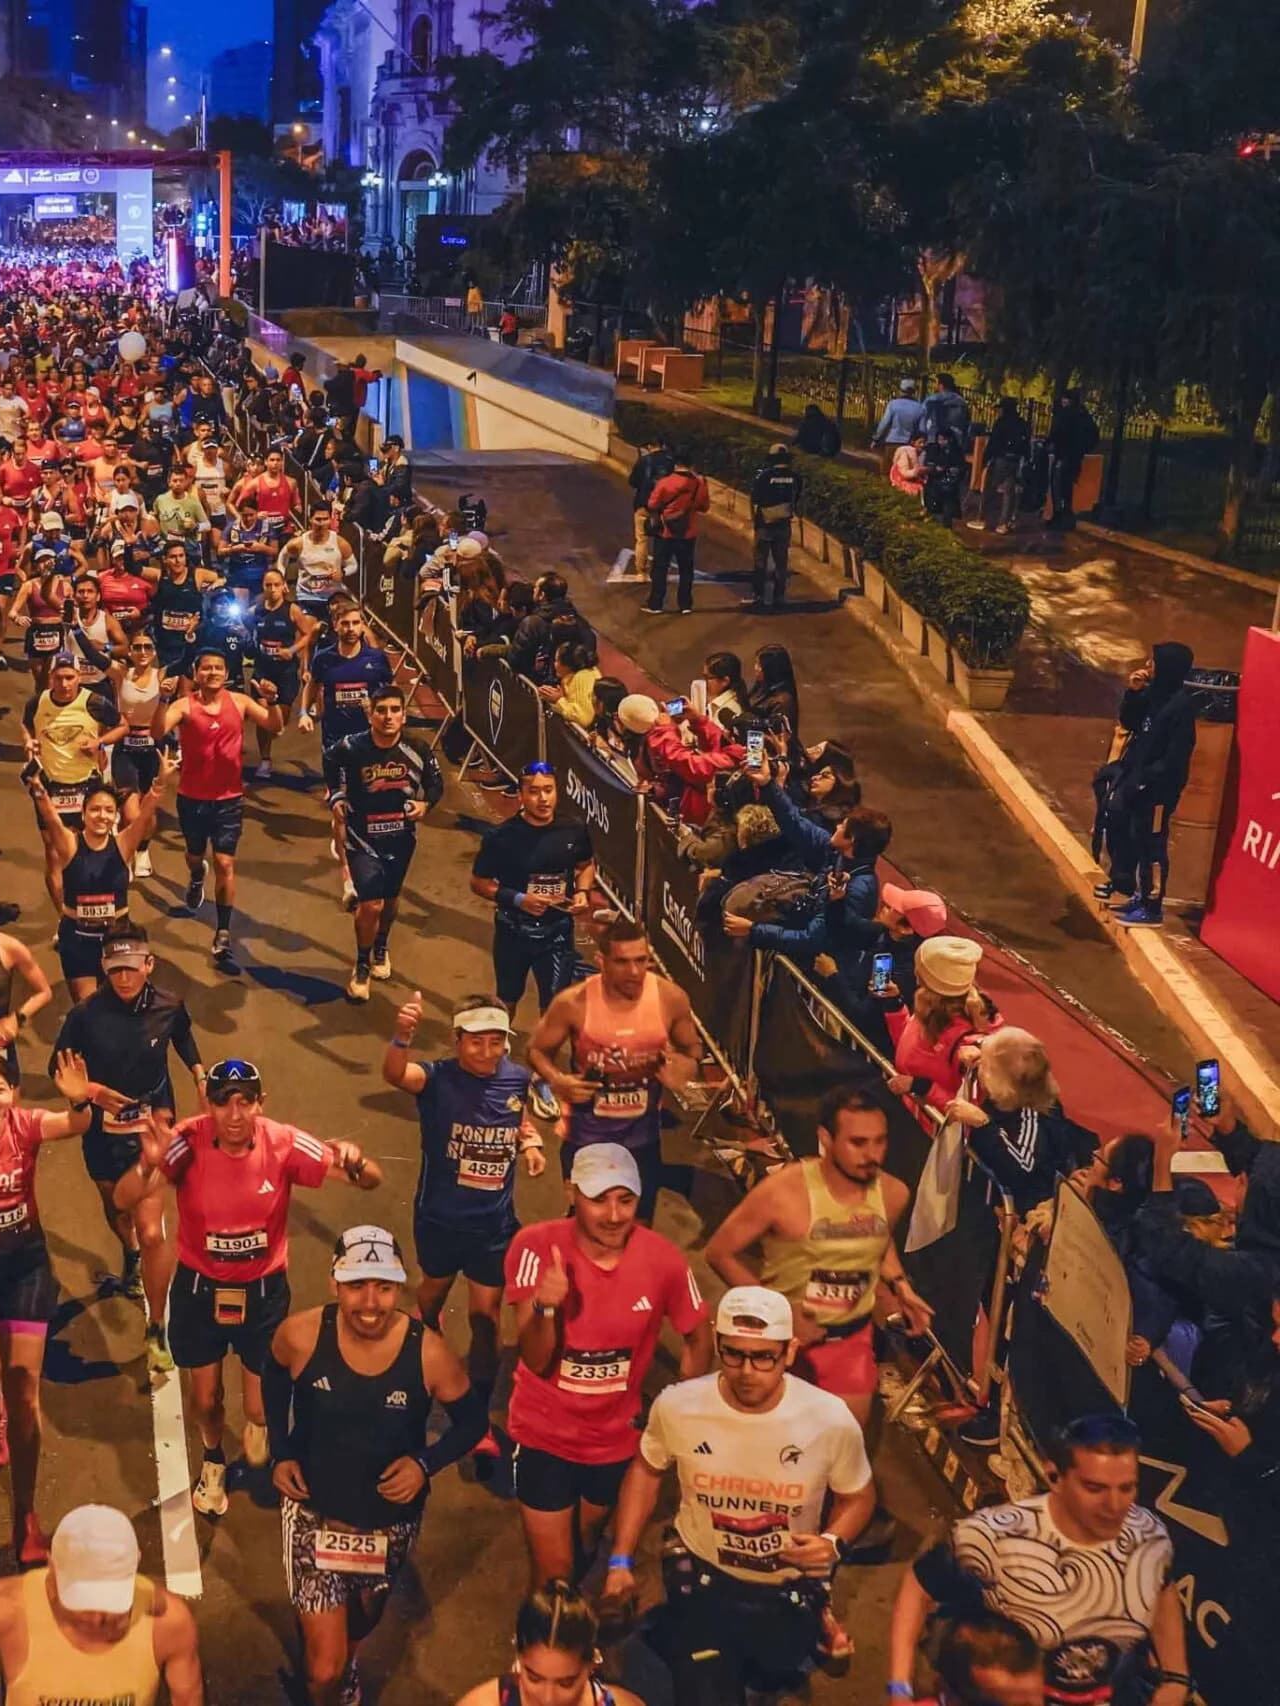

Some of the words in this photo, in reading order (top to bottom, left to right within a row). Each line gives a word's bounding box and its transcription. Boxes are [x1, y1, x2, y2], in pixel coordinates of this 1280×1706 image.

[534, 884, 561, 895] 2635
[468, 1161, 505, 1177] 4829
[213, 1236, 262, 1251] 11901
[570, 1365, 620, 1379] 2333
[693, 1472, 804, 1501] CHRONO
[696, 1493, 804, 1517] RUNNERS
[325, 1533, 377, 1554] 2525
[723, 1533, 783, 1555] 13469
